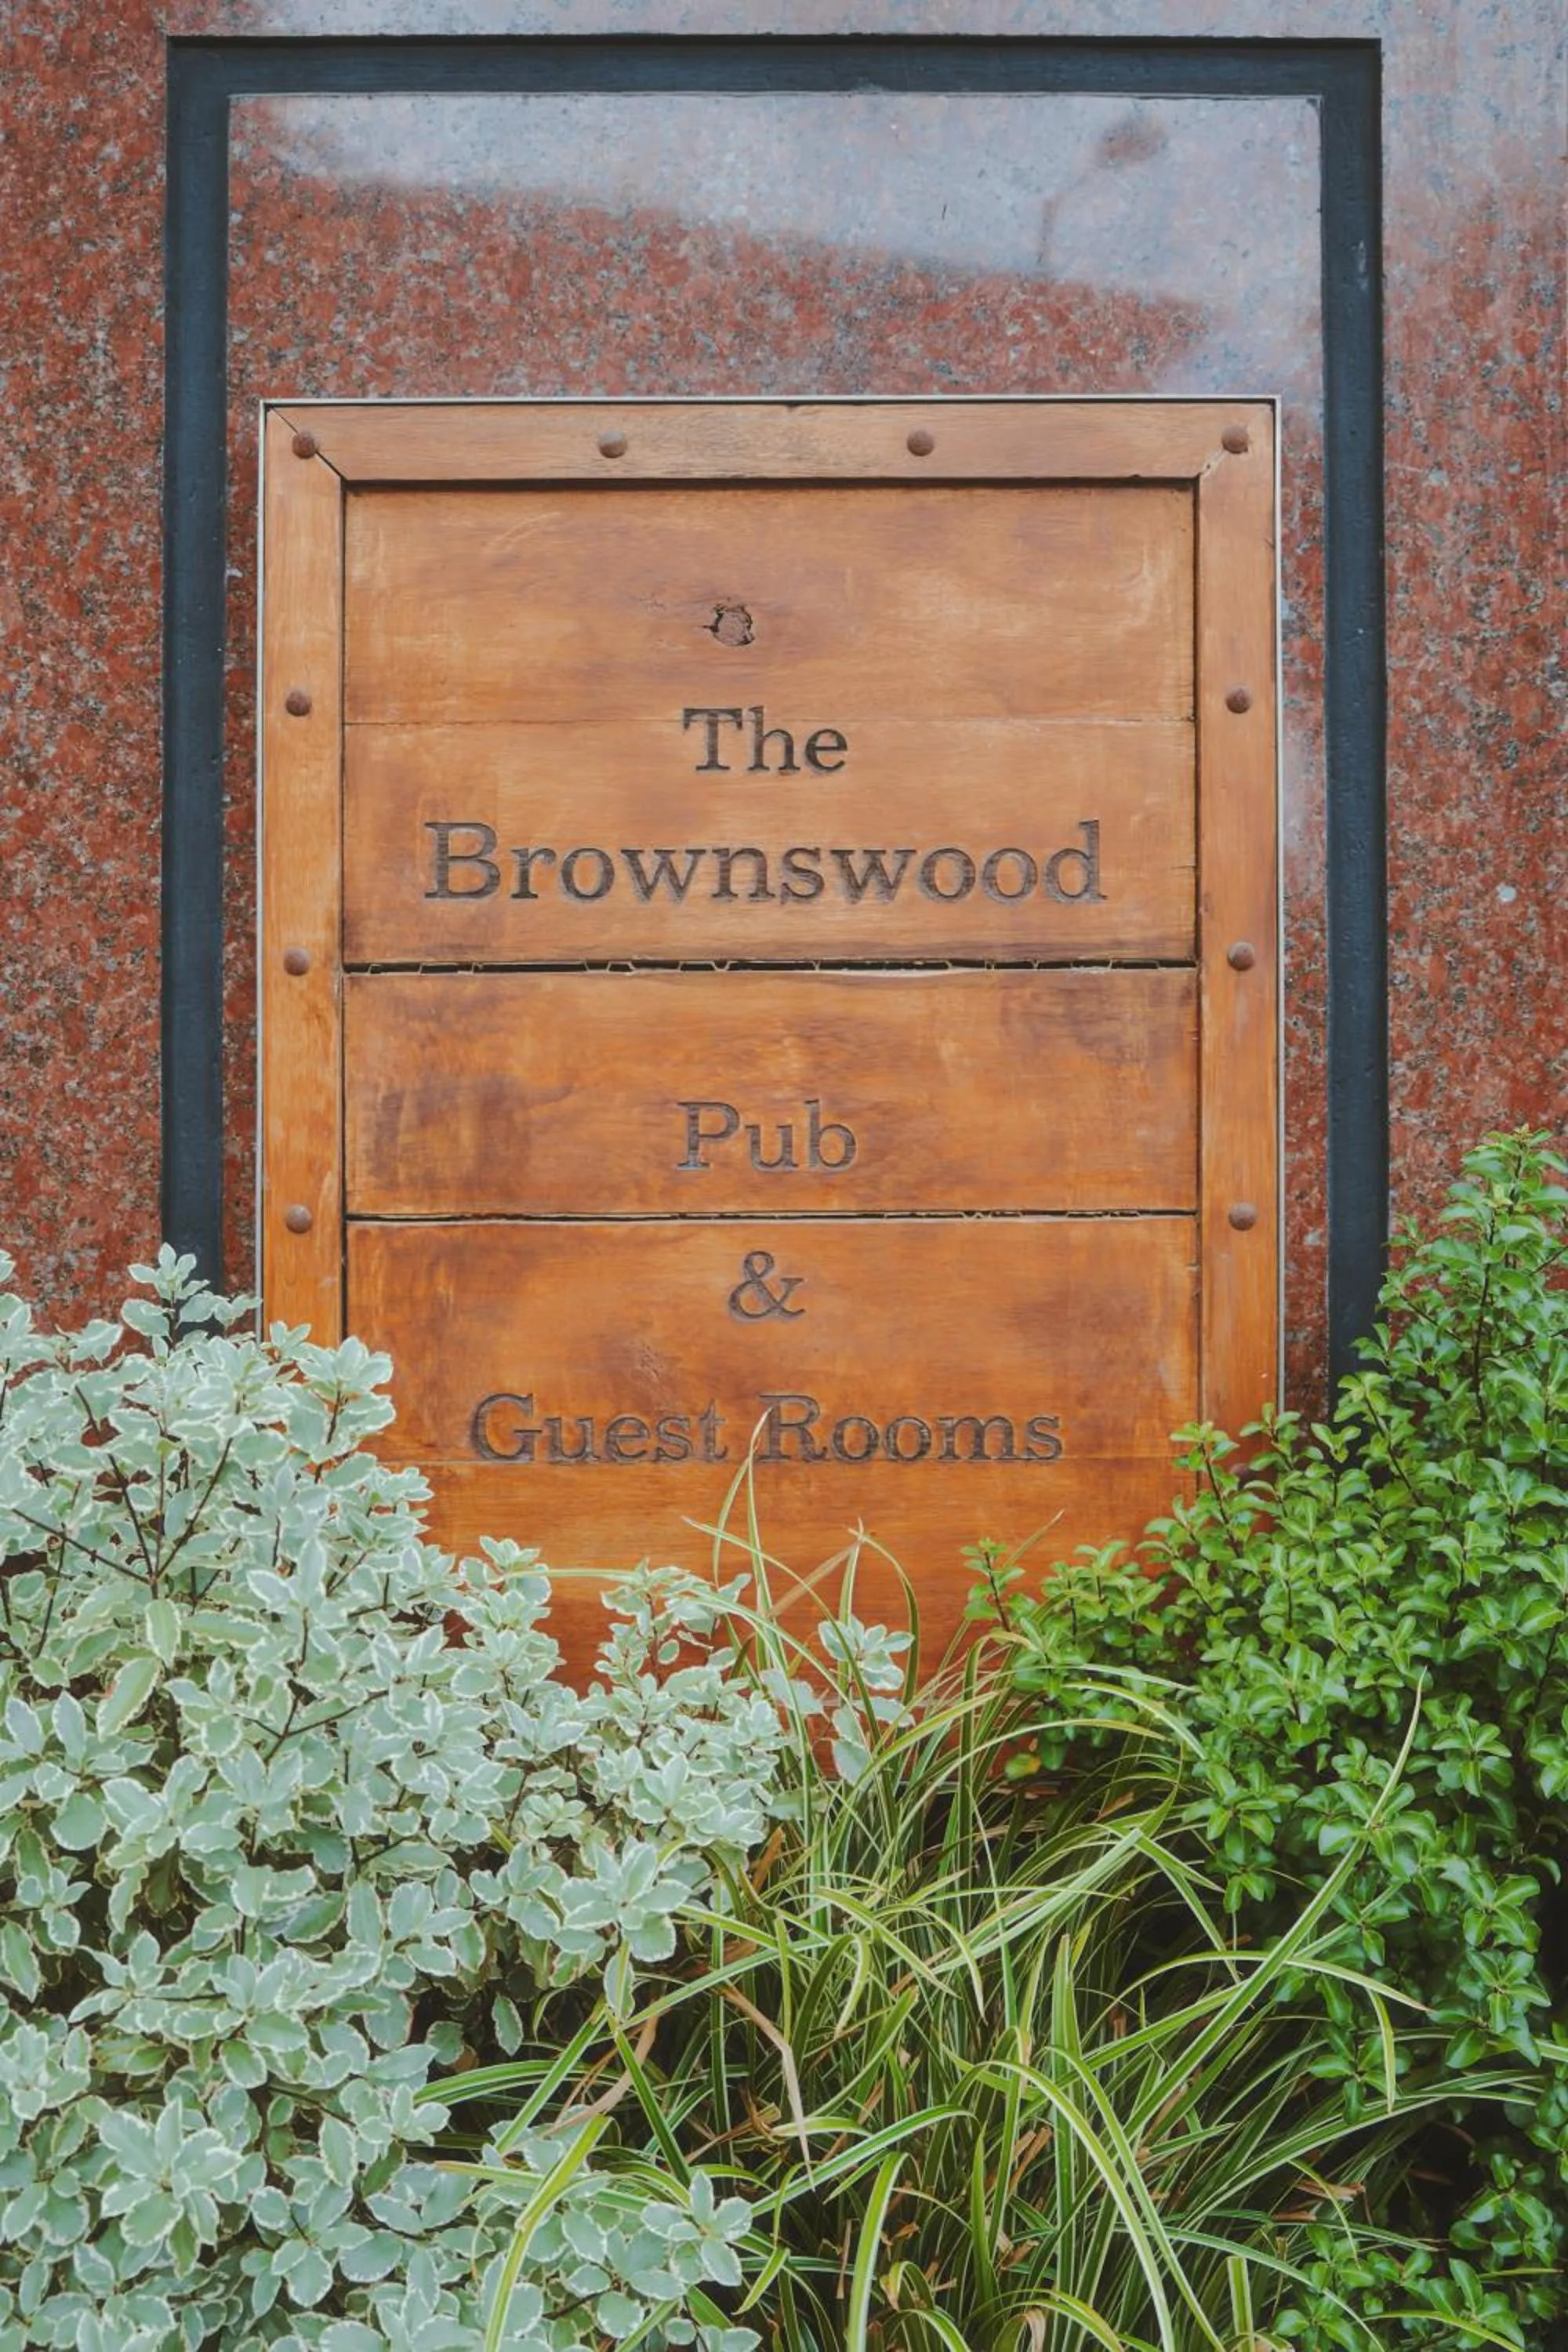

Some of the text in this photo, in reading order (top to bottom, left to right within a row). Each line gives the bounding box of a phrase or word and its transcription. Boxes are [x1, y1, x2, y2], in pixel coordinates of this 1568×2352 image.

[681, 705, 848, 773] The
[423, 818, 1107, 905] Brownswood
[676, 1098, 857, 1172] Pub
[728, 1250, 806, 1321] &
[470, 1392, 1063, 1464] Guest Rooms
